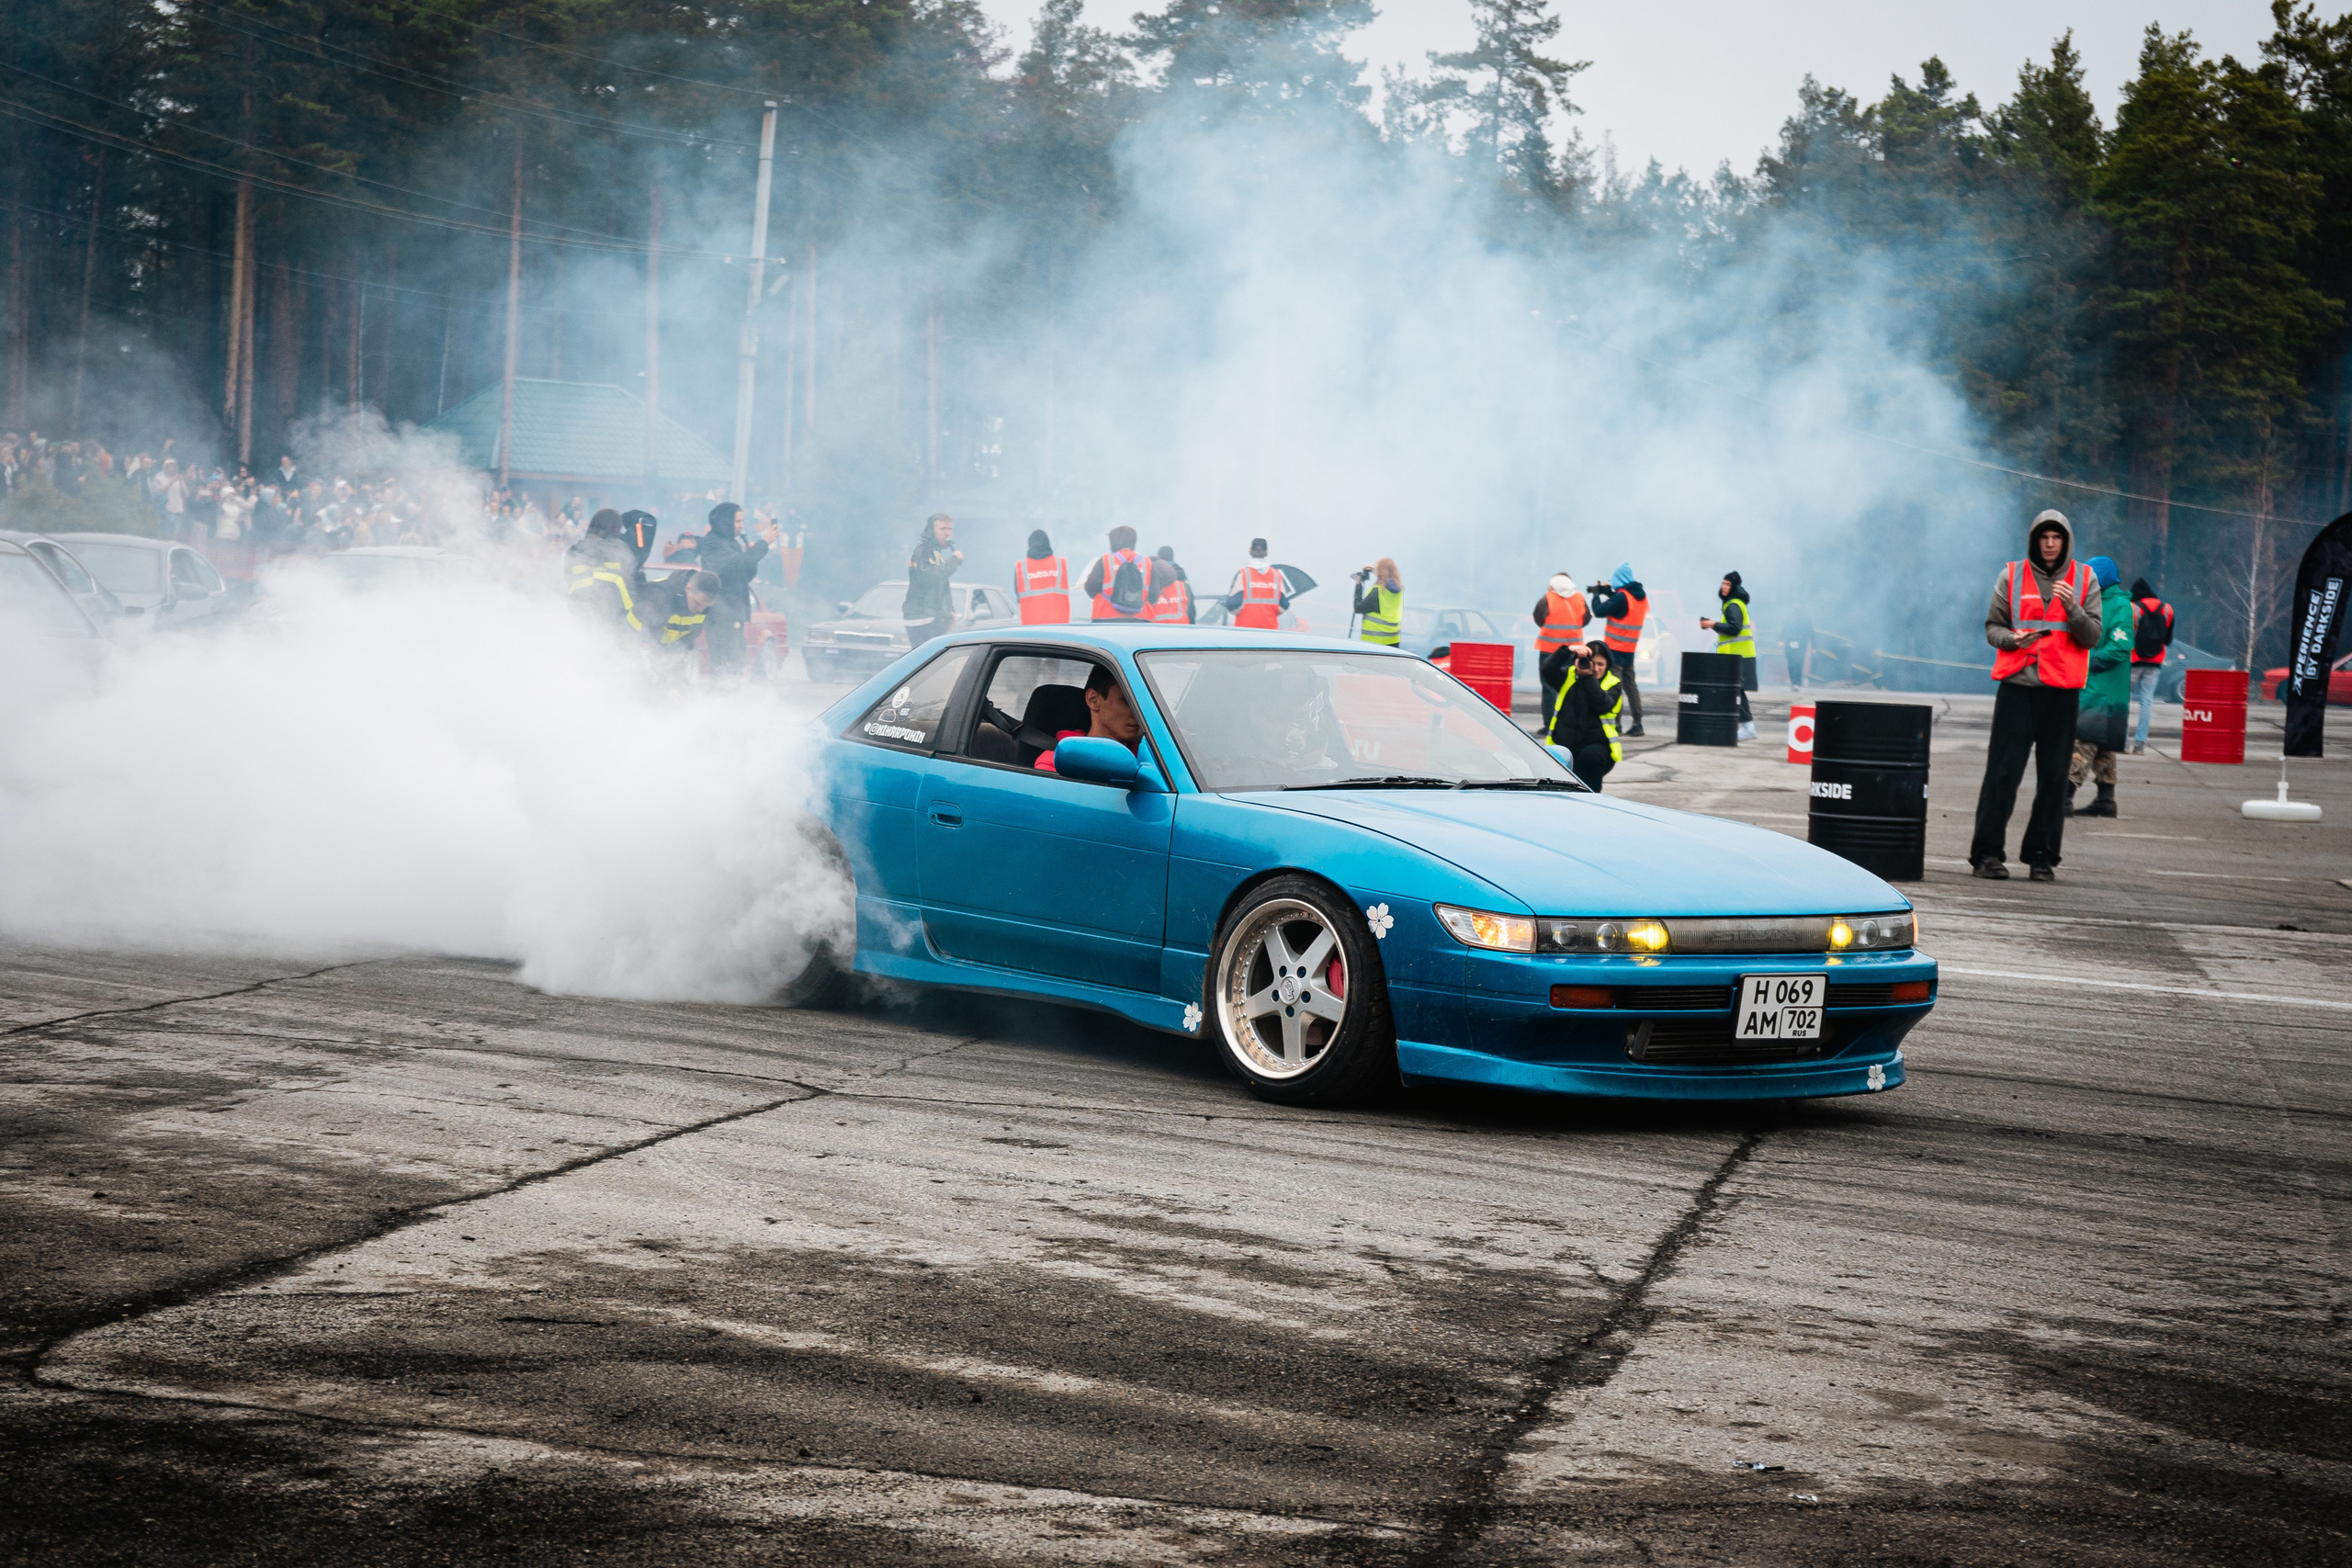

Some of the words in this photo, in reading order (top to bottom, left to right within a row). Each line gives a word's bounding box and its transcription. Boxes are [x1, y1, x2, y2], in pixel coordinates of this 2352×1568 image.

[2311, 581, 2340, 654] DARKSIDE
[2306, 658, 2319, 676] BY
[1753, 979, 1770, 1005] H
[1775, 979, 1814, 1005] 069
[1743, 1010, 1779, 1036] AM
[1787, 1010, 1817, 1030] 702
